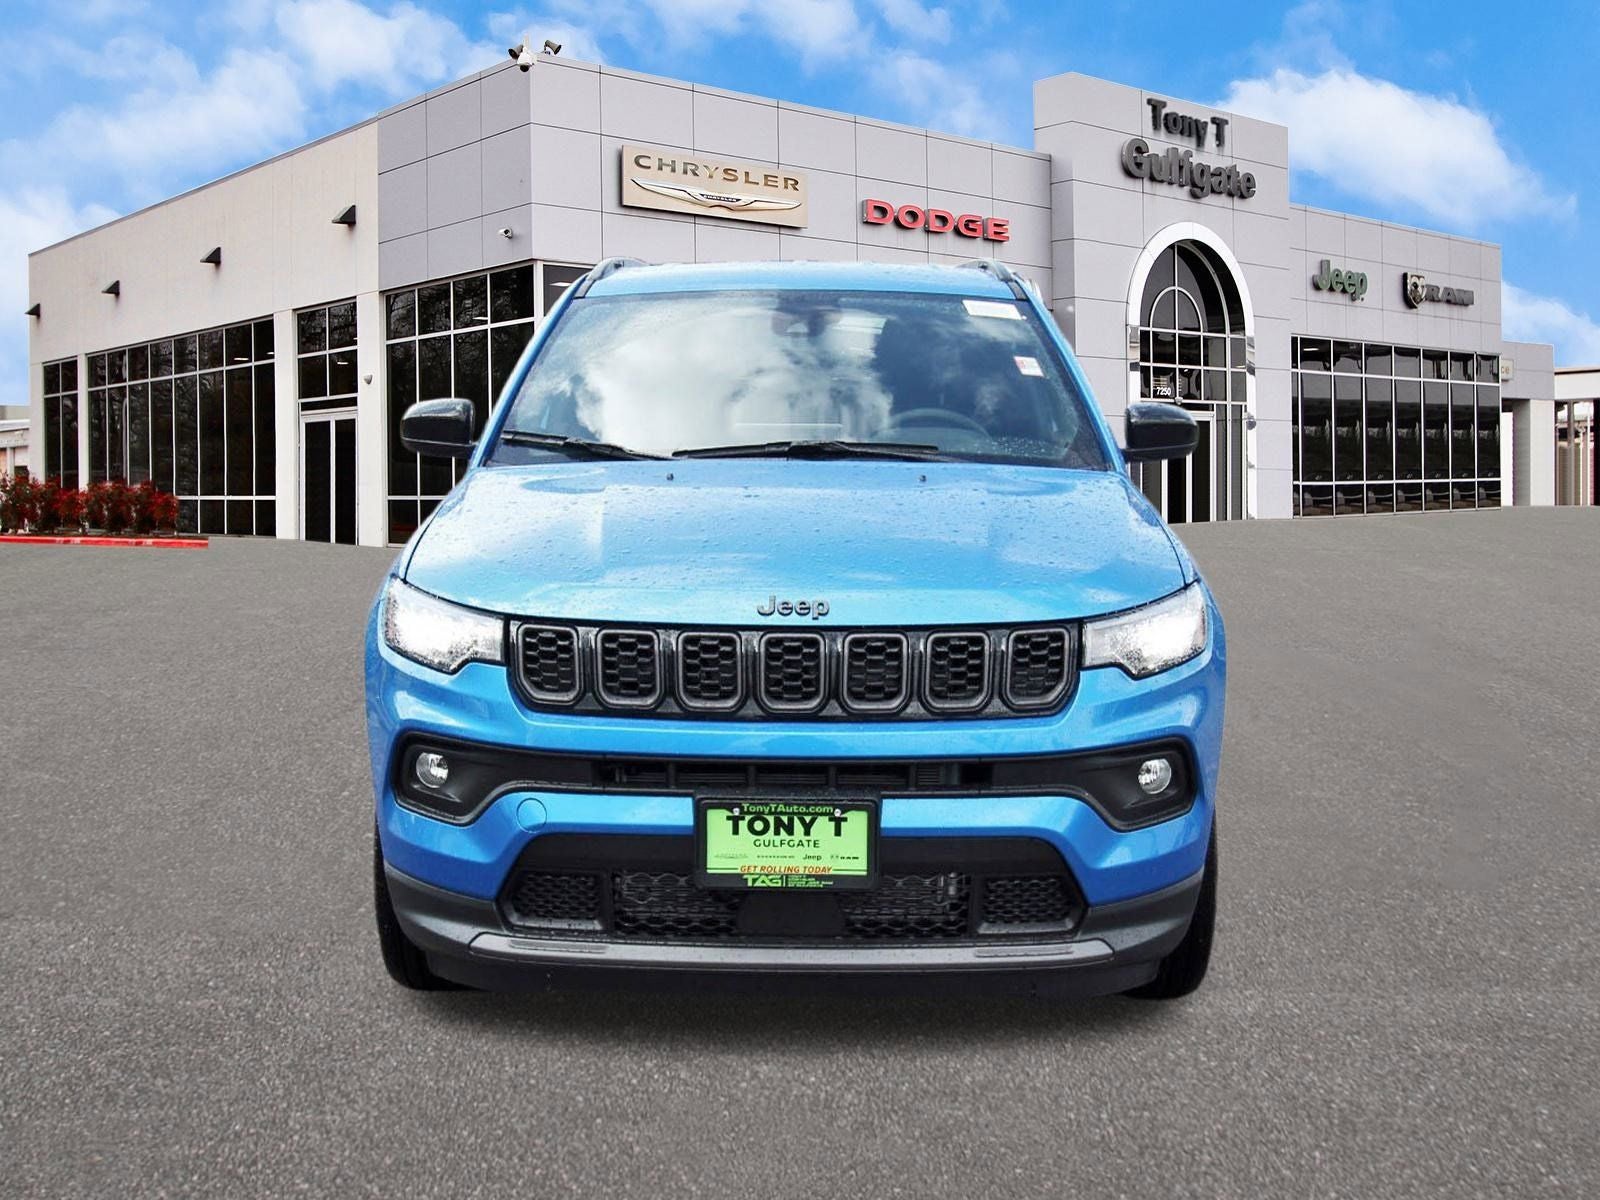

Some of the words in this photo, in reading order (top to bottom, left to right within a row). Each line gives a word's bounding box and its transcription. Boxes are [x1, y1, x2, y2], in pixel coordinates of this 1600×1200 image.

[1147, 98, 1208, 147] Tony
[1211, 115, 1229, 147] T
[633, 154, 800, 192] CHRYSLER
[1121, 138, 1256, 199] Gulfgate
[862, 198, 1011, 243] DODGE
[1312, 259, 1368, 301] Jeep
[1424, 284, 1475, 306] RAM
[1156, 387, 1172, 396] 7250
[757, 595, 830, 620] Jeep
[743, 804, 833, 814] TonyTAuto.com
[726, 815, 819, 837] TONY
[828, 816, 848, 837] T
[753, 839, 821, 848] GULFGATE
[740, 865, 757, 873] GET
[759, 865, 800, 873] ROLLING
[803, 866, 833, 874] TODAY
[743, 875, 782, 887] TAG
